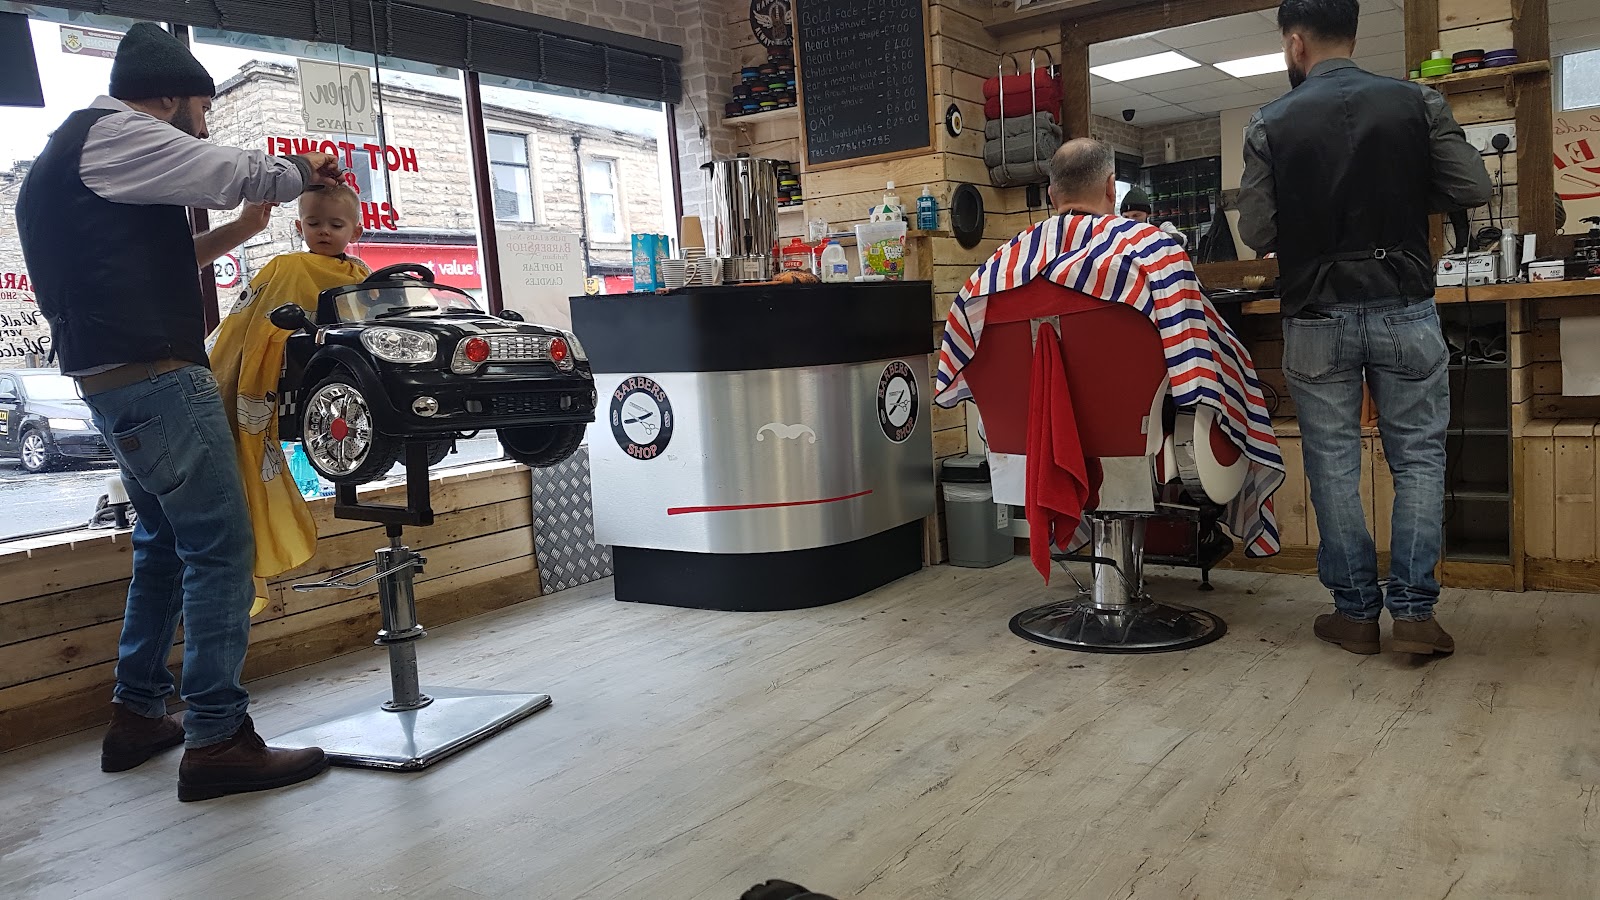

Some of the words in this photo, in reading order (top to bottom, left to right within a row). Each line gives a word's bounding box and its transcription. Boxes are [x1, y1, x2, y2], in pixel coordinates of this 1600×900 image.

[805, 38, 830, 53] Beard
[832, 36, 849, 46] trim
[806, 53, 832, 65] Beard
[836, 49, 855, 60] trim
[805, 66, 838, 79] Children
[840, 61, 862, 72] under
[864, 58, 873, 67] 10
[830, 73, 856, 86] nostril
[859, 70, 878, 80] wax
[809, 114, 834, 131] OAP
[214, 262, 235, 277] 20
[438, 259, 474, 276] value
[879, 362, 909, 399] BARBERS
[614, 376, 666, 403] BARBERS
[895, 416, 914, 440] SHOP
[627, 443, 658, 459] SHOP
